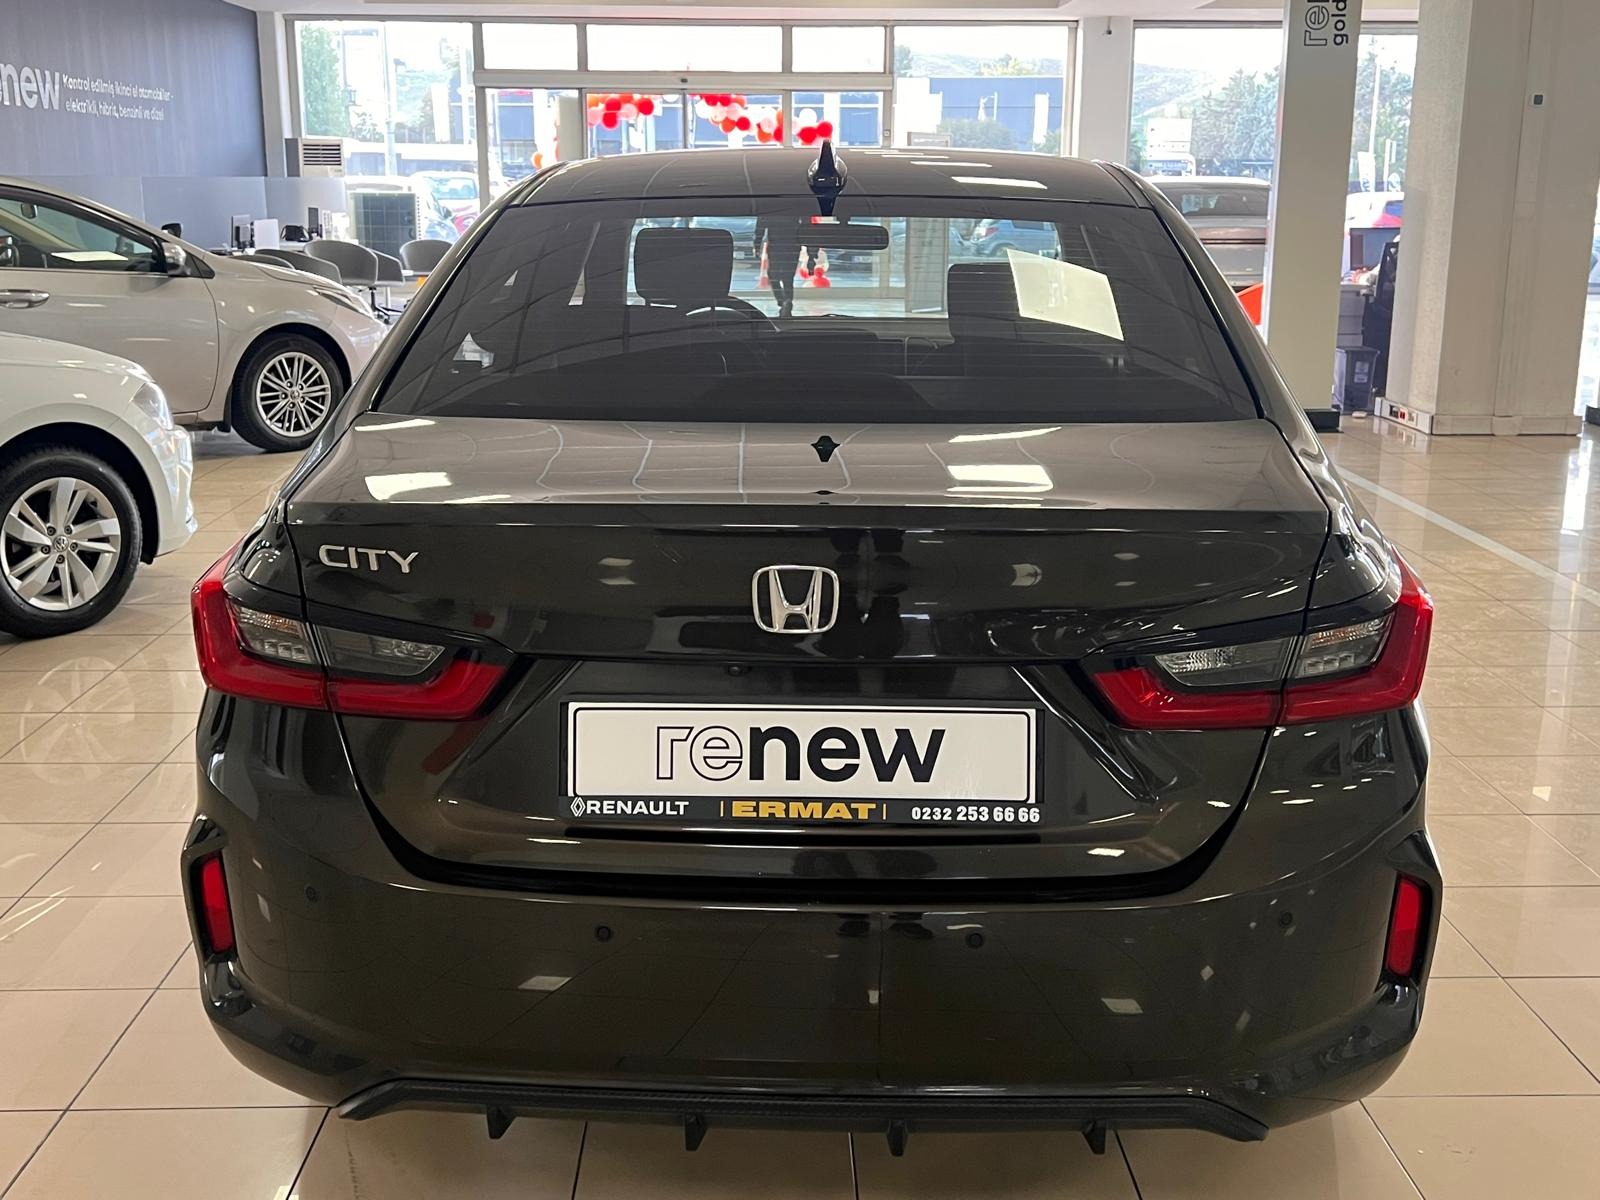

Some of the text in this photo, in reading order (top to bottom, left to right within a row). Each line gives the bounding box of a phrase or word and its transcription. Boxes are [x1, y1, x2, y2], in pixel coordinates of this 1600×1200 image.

[1304, 0, 1330, 46] re
[1332, 0, 1349, 46] gold
[62, 73, 90, 91] Kontrol
[319, 544, 419, 574] CITY
[656, 725, 946, 783] renew
[586, 800, 1041, 823] RENAULT ERMAT 0232 253 66 66
